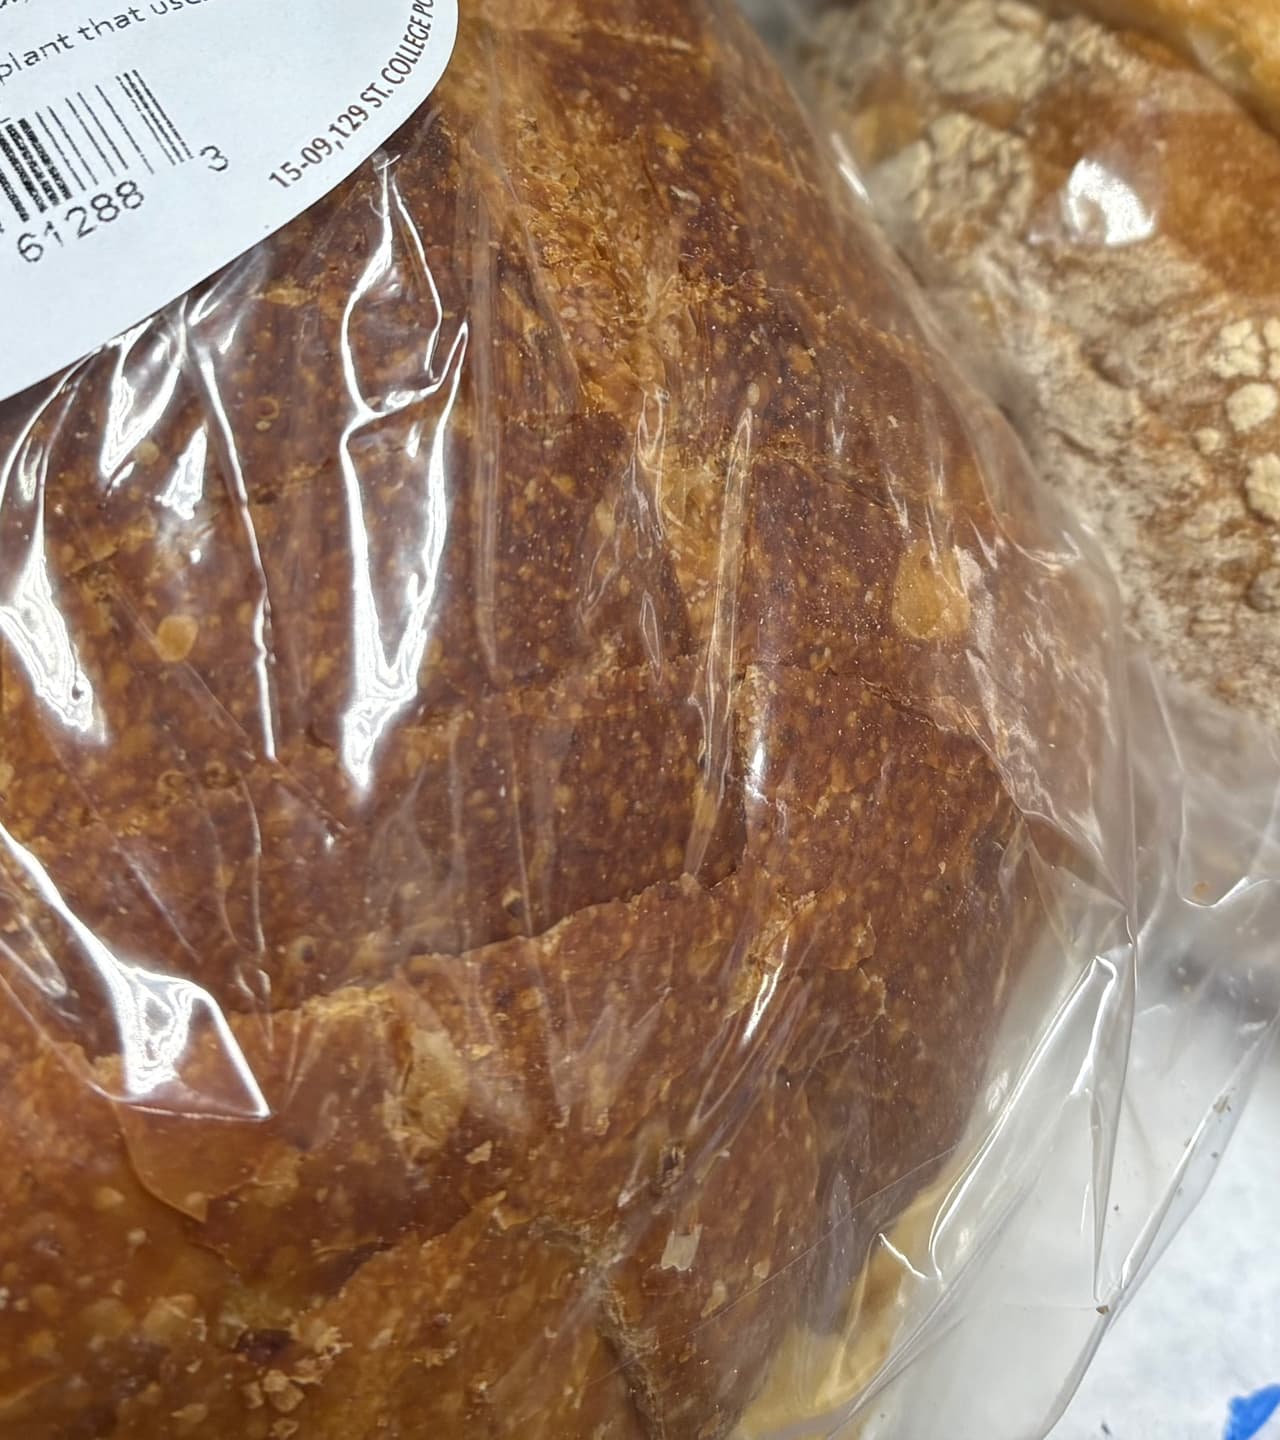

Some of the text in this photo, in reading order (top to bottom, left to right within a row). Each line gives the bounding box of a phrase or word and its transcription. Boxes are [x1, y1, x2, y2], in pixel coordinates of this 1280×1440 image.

[78, 5, 147, 44] that
[359, 81, 395, 110] ST.
[380, 14, 433, 86] COLLEGE
[16, 179, 146, 264] 61288
[198, 144, 231, 174] 3
